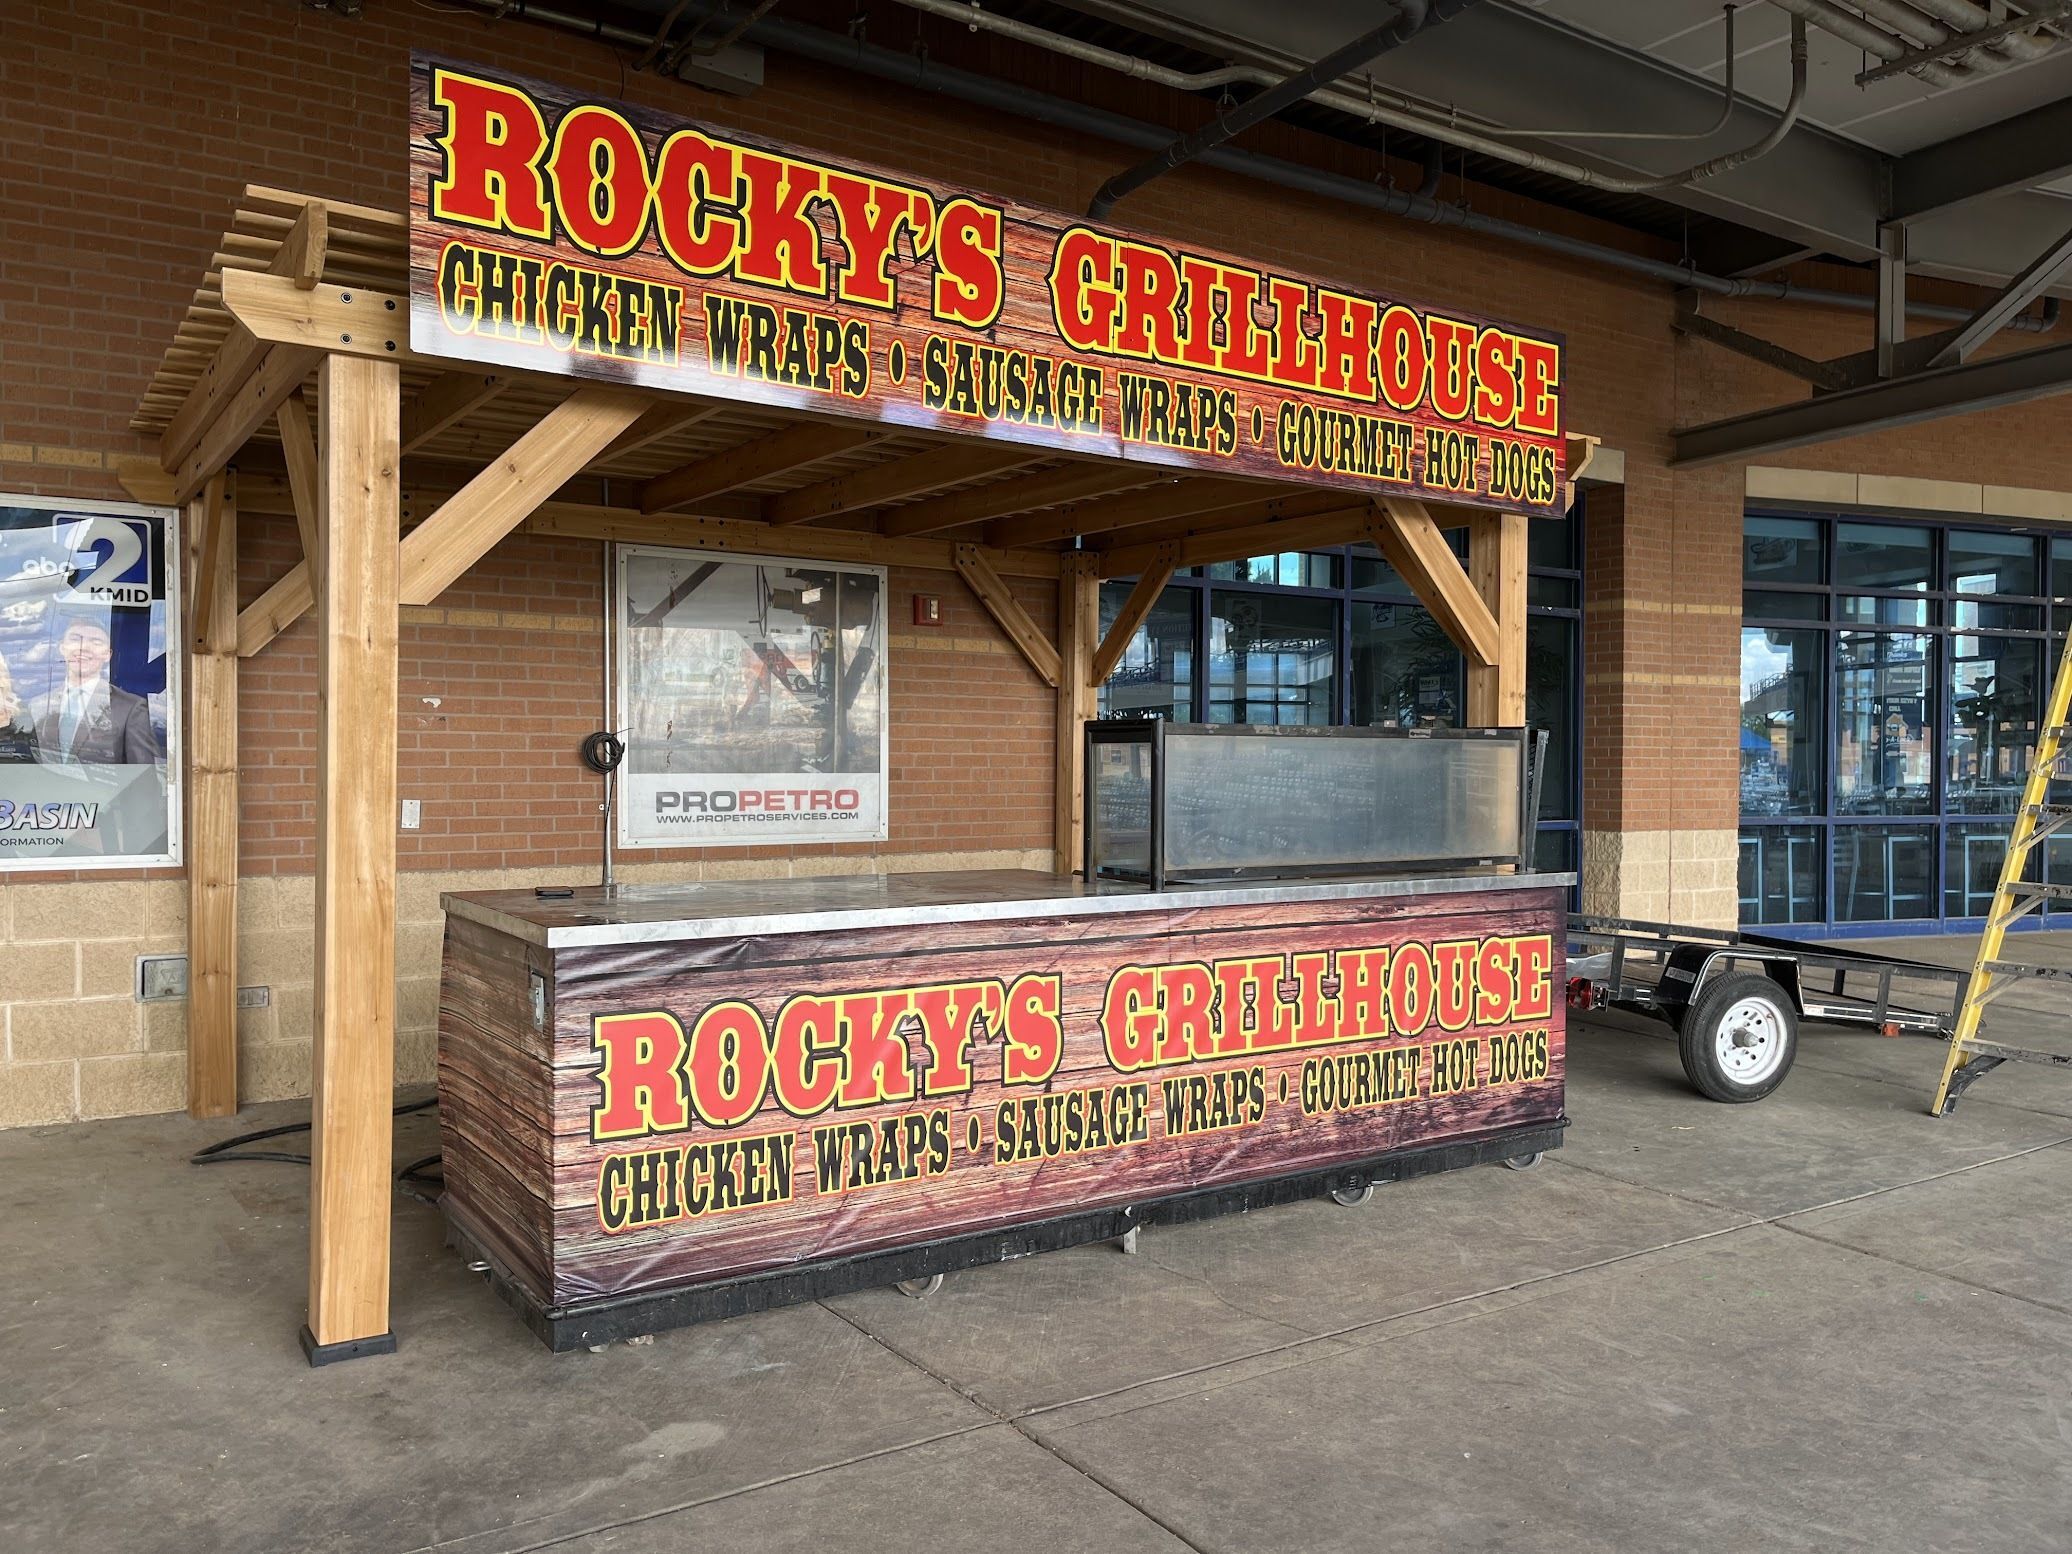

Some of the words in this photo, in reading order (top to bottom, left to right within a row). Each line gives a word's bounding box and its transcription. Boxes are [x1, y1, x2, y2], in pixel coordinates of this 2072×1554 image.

[434, 68, 1003, 328] ROCKY'S
[1047, 226, 1560, 437] GRILLHOUSE
[438, 242, 684, 368] CHICKEN
[703, 293, 870, 399] WRAPS
[923, 335, 1102, 438] SAUSAGE
[1119, 373, 1237, 456] WRAPS
[1276, 400, 1413, 483] GOURMET
[1424, 428, 1479, 495] HOT
[1488, 439, 1556, 504] DOGS
[64, 518, 142, 593] 2
[90, 586, 149, 603] KMID
[0, 800, 98, 830] BASIN
[655, 789, 860, 813] PROPETRO
[656, 812, 859, 824] WWW.PROPETROSERVICES.COM
[592, 974, 1062, 1141] ROCKY'S
[1099, 934, 1553, 1071] GRILLHOUSE
[598, 1132, 796, 1233] CHICKEN
[812, 1108, 950, 1195] WRAPS
[994, 1083, 1149, 1166] SAUSAGE
[1162, 1065, 1266, 1137] WRAPS
[1299, 1046, 1421, 1115] GOURMET
[1430, 1038, 1479, 1095] HOT
[1487, 1029, 1550, 1086] DOGS
